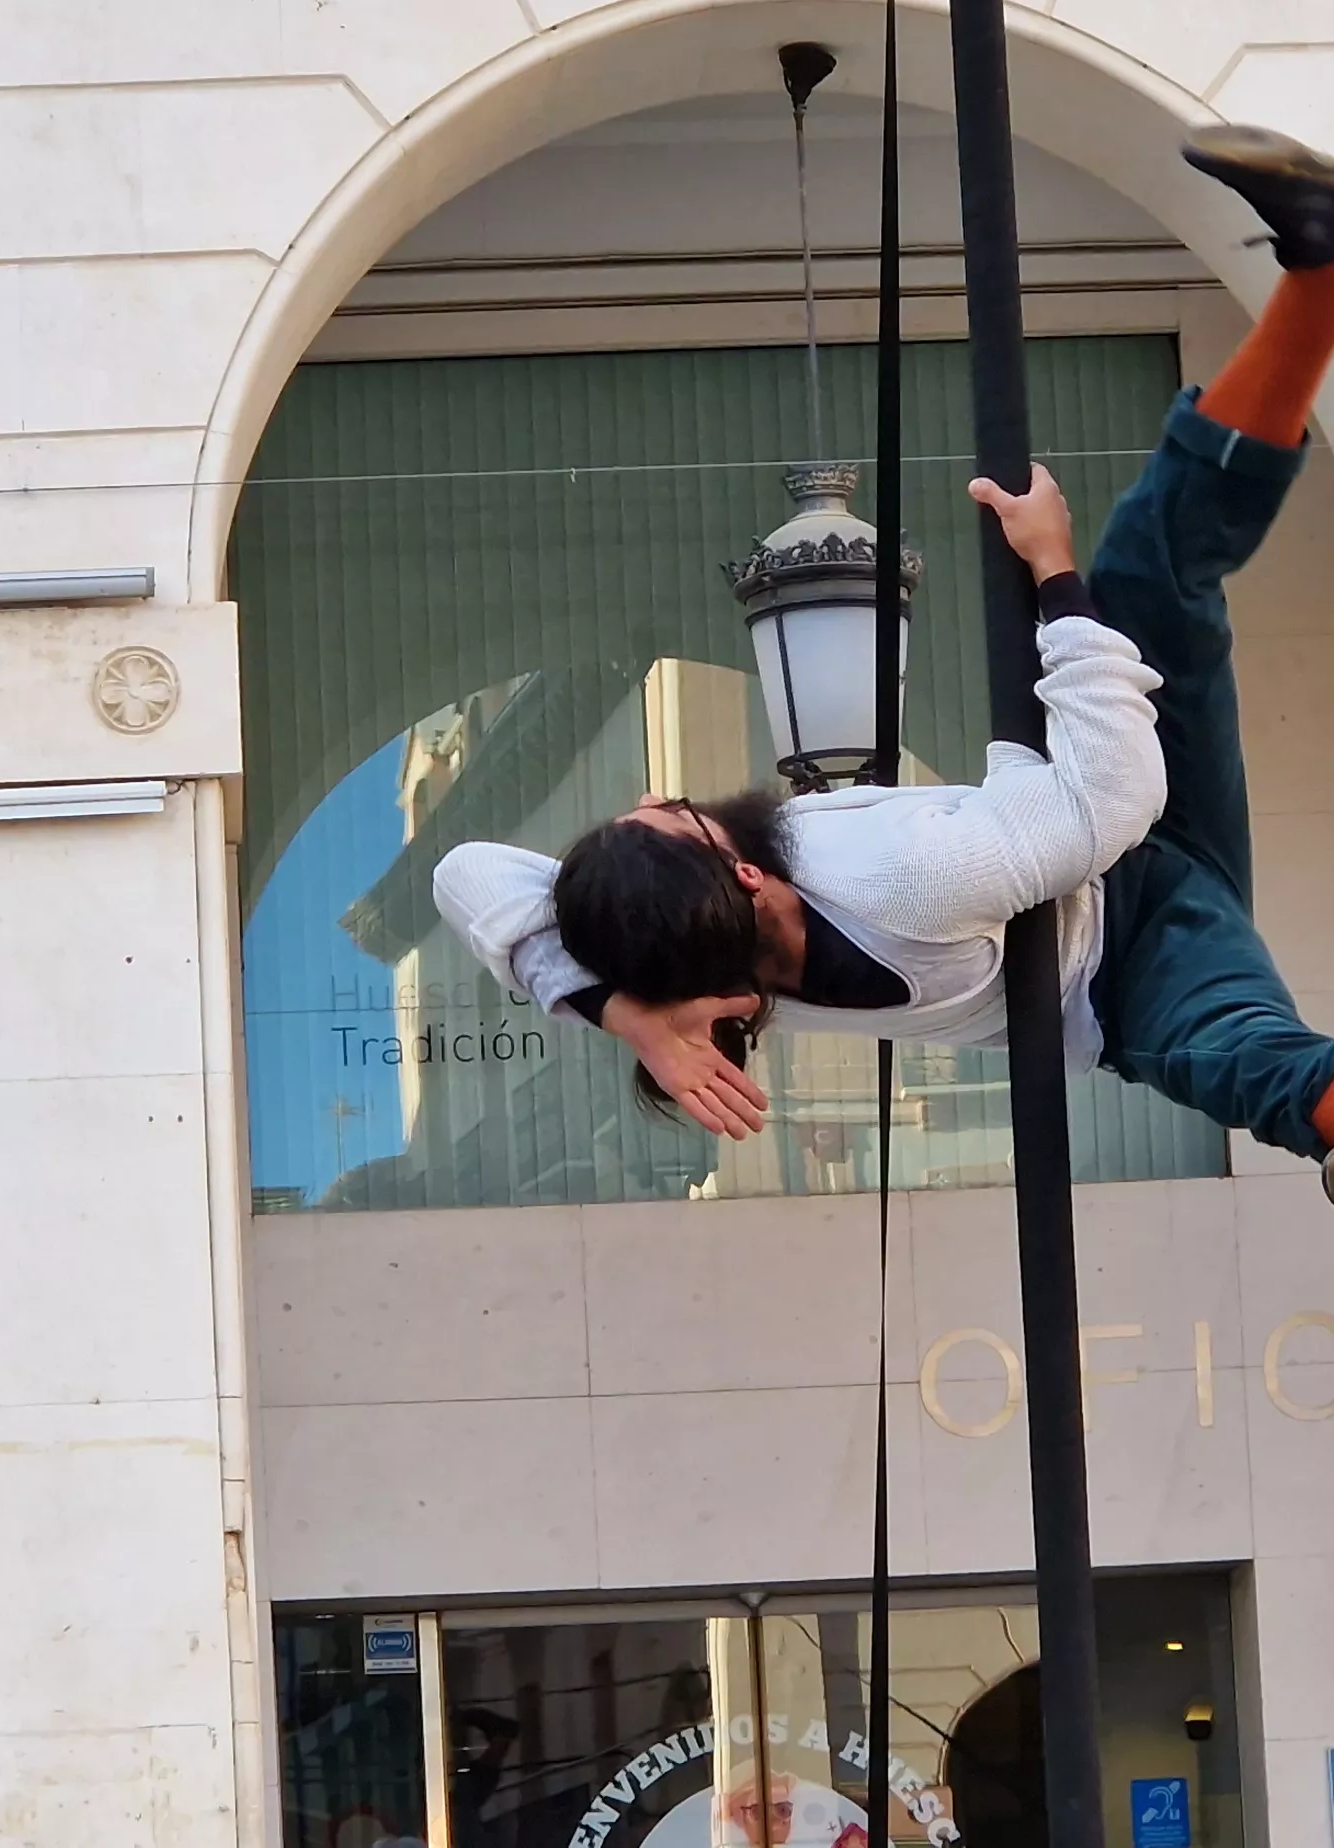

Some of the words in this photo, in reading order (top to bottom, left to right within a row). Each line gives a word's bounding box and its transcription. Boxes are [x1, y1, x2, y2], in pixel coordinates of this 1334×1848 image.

[331, 972, 499, 1012] Huesc
[331, 1019, 545, 1067] Tradición
[799, 1719, 831, 1752] A
